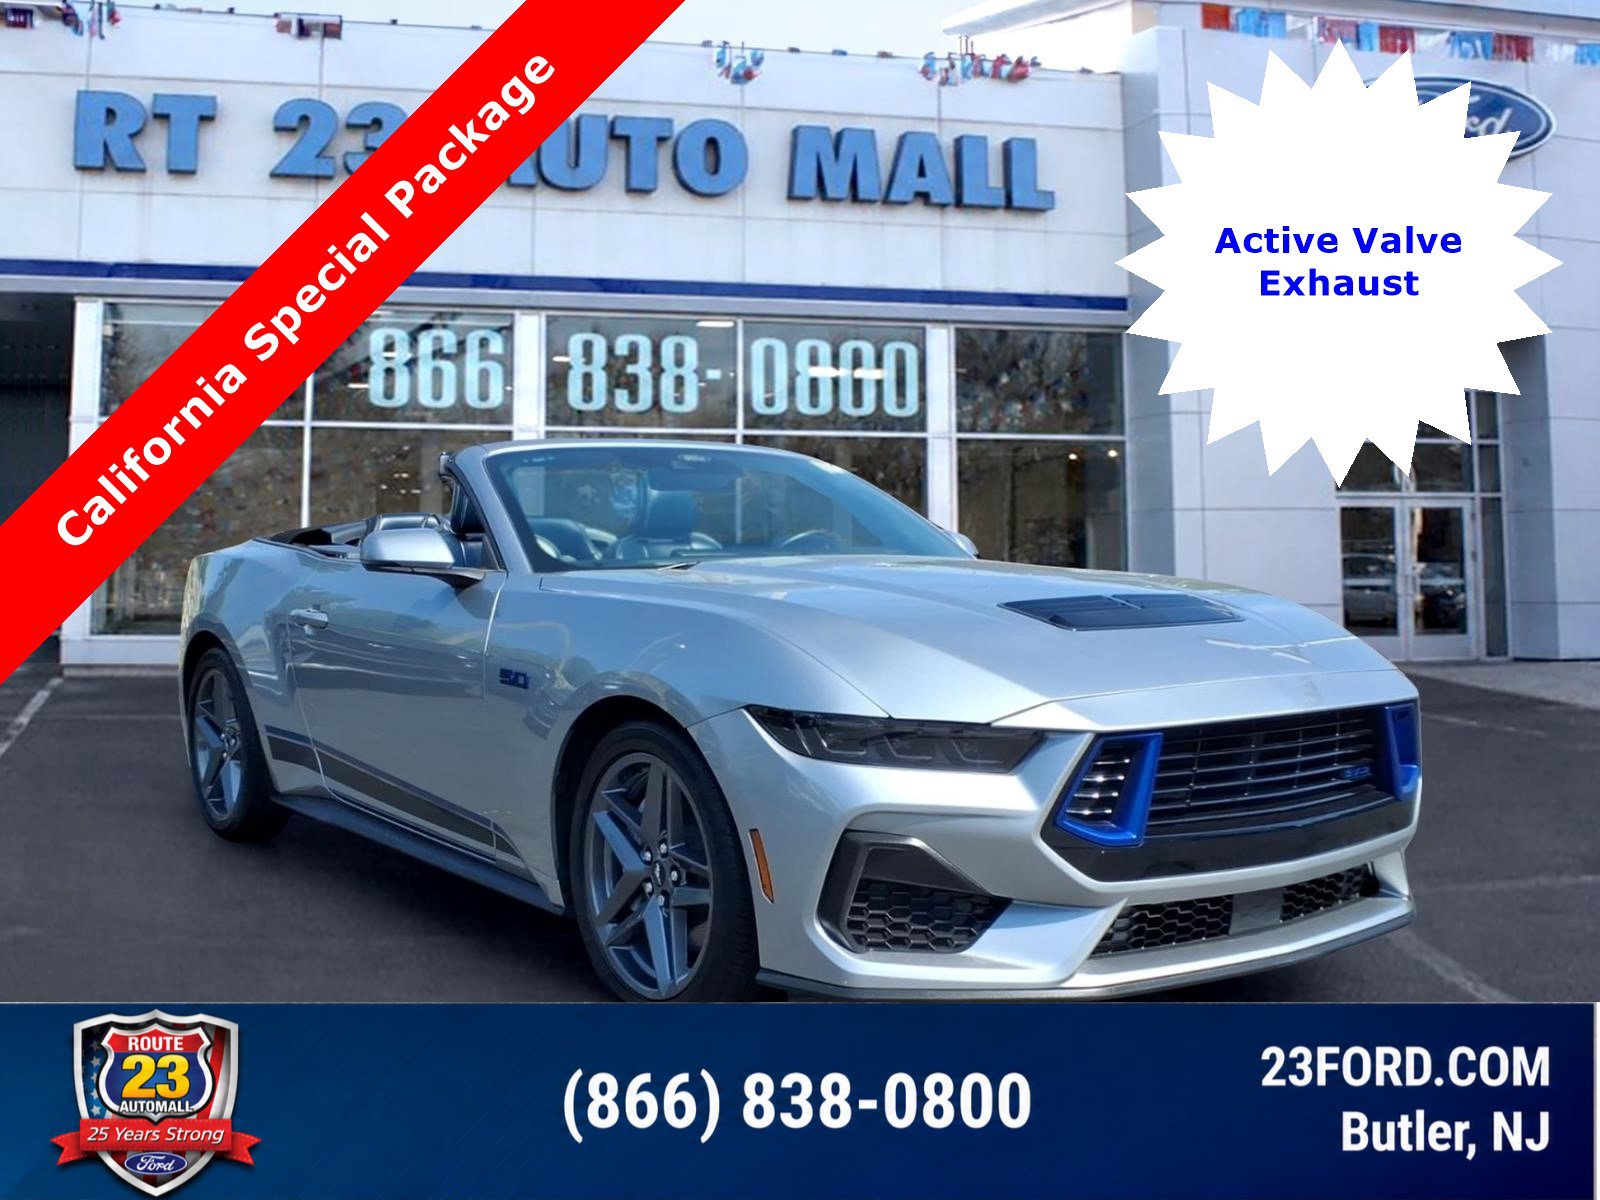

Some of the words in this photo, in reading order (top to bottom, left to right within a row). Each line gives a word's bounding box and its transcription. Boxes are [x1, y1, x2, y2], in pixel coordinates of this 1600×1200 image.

[73, 89, 217, 174] RT
[270, 98, 408, 179] 23
[506, 113, 748, 197] UTO
[787, 125, 1054, 212] MALL
[368, 327, 505, 409] 866
